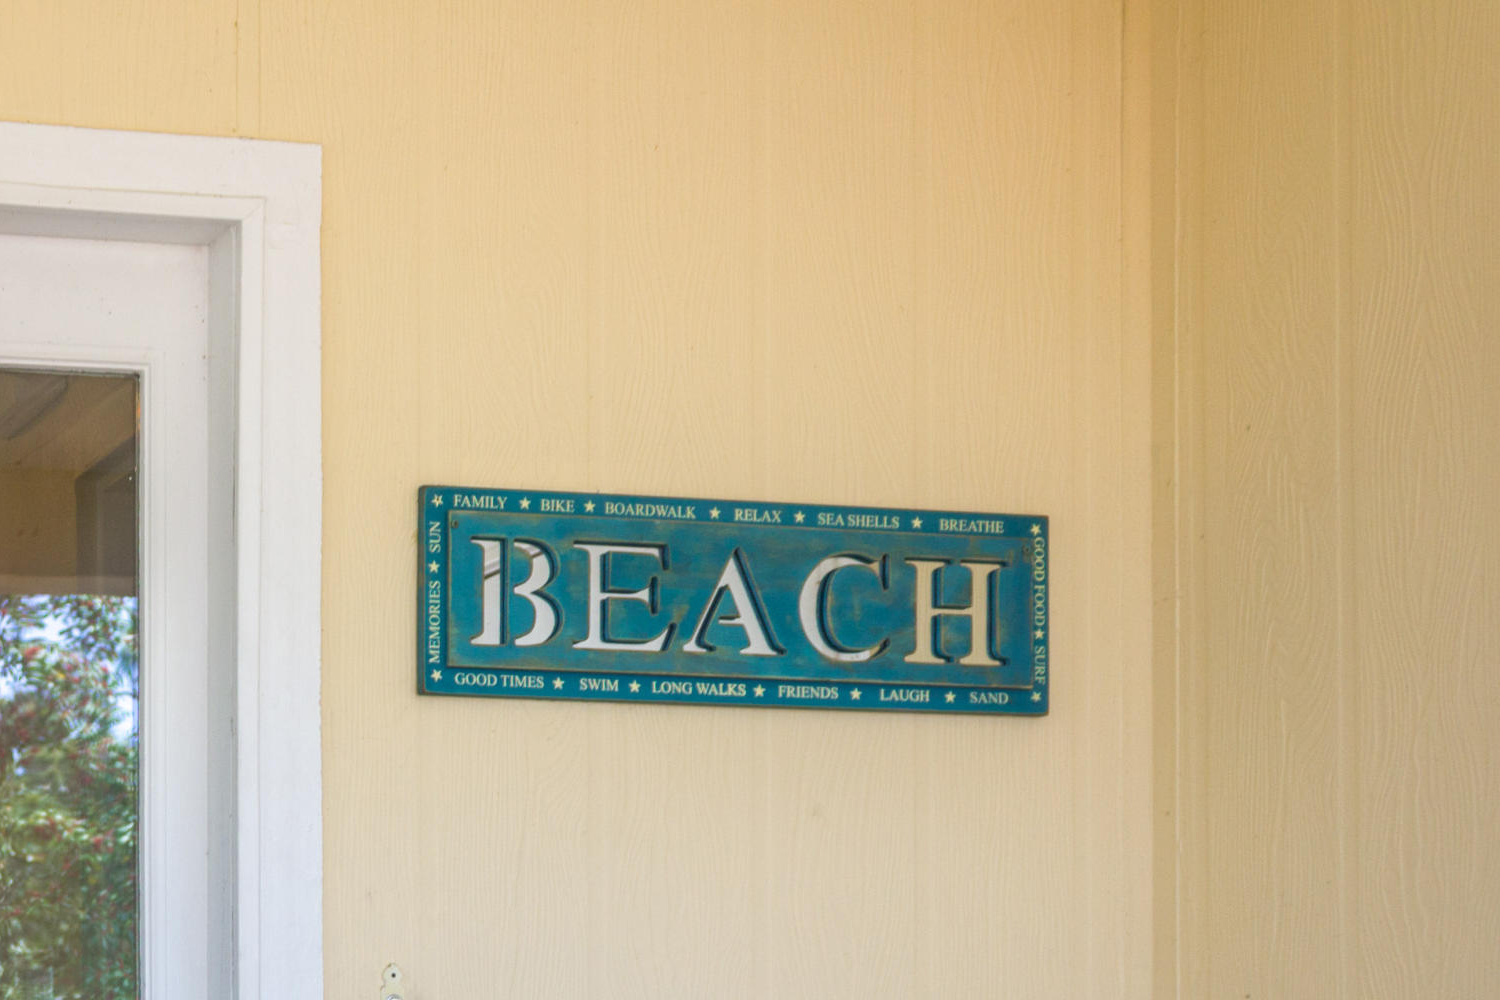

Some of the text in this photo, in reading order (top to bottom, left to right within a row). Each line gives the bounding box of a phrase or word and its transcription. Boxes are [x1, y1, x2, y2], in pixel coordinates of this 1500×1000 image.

[453, 494, 1004, 534] FAMILY BIKE BOARDWALK RELAX SEA SHELLS BREATHE
[428, 520, 441, 664] MEMORIES SUN
[469, 535, 1010, 667] BEACH
[1033, 537, 1046, 685] GOOD FOOD SURF
[454, 672, 1009, 705] GOOD TIMES SWIM LONG WALKS FRIENDS LAUGH SAND
